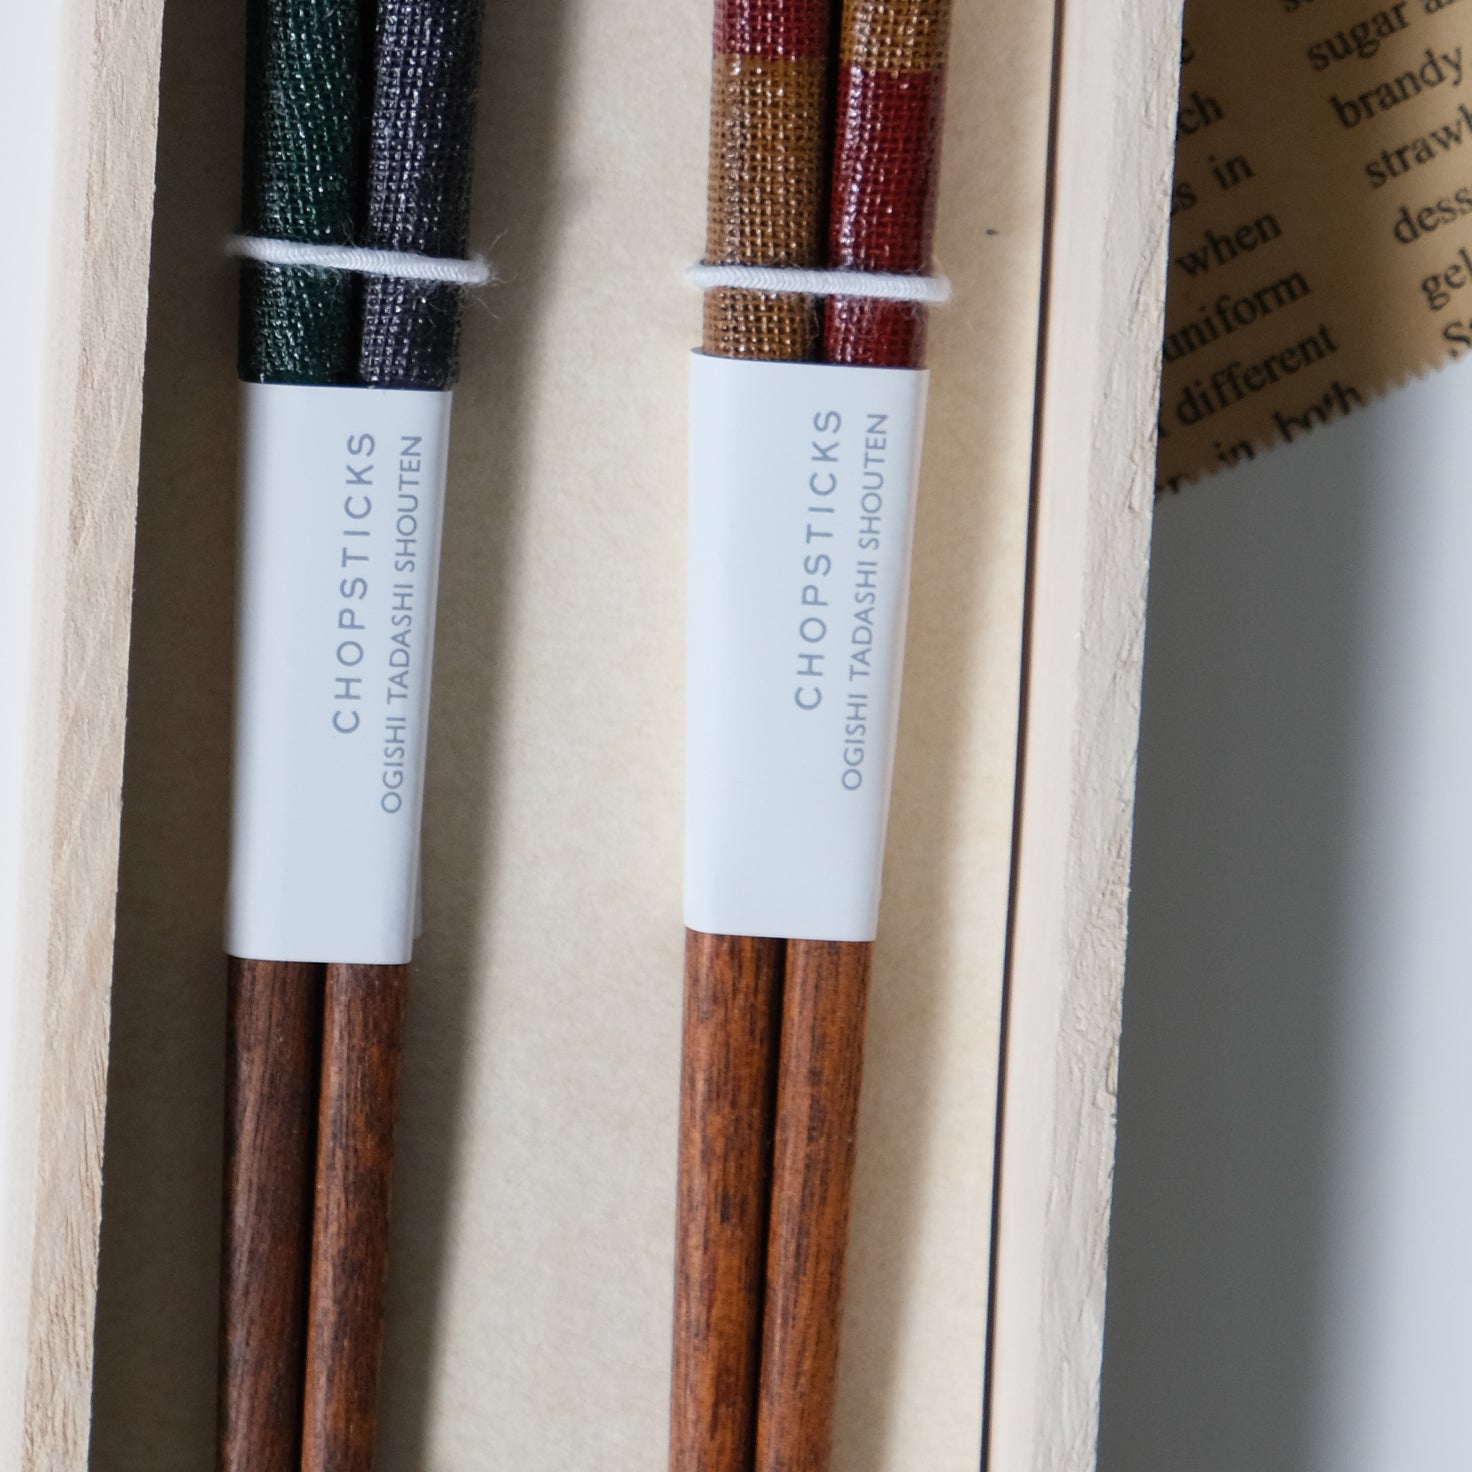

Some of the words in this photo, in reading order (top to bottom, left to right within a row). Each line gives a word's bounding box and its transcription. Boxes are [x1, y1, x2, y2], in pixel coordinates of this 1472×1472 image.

[1307, 0, 1409, 71] sugar
[1330, 46, 1463, 128] brandy
[1208, 154, 1255, 191] in
[1175, 213, 1283, 277] when
[1176, 324, 1339, 426] different
[393, 434, 423, 573] SHOUTEN
[858, 413, 888, 550] SHOUTEN
[331, 432, 377, 734] CHOPSTICKS
[794, 409, 842, 710] CHOPSTICKS
[386, 582, 416, 705] TADASHI
[848, 561, 878, 682] TADASHI
[380, 716, 407, 814] OGISHI
[840, 693, 868, 791] OGISHI
